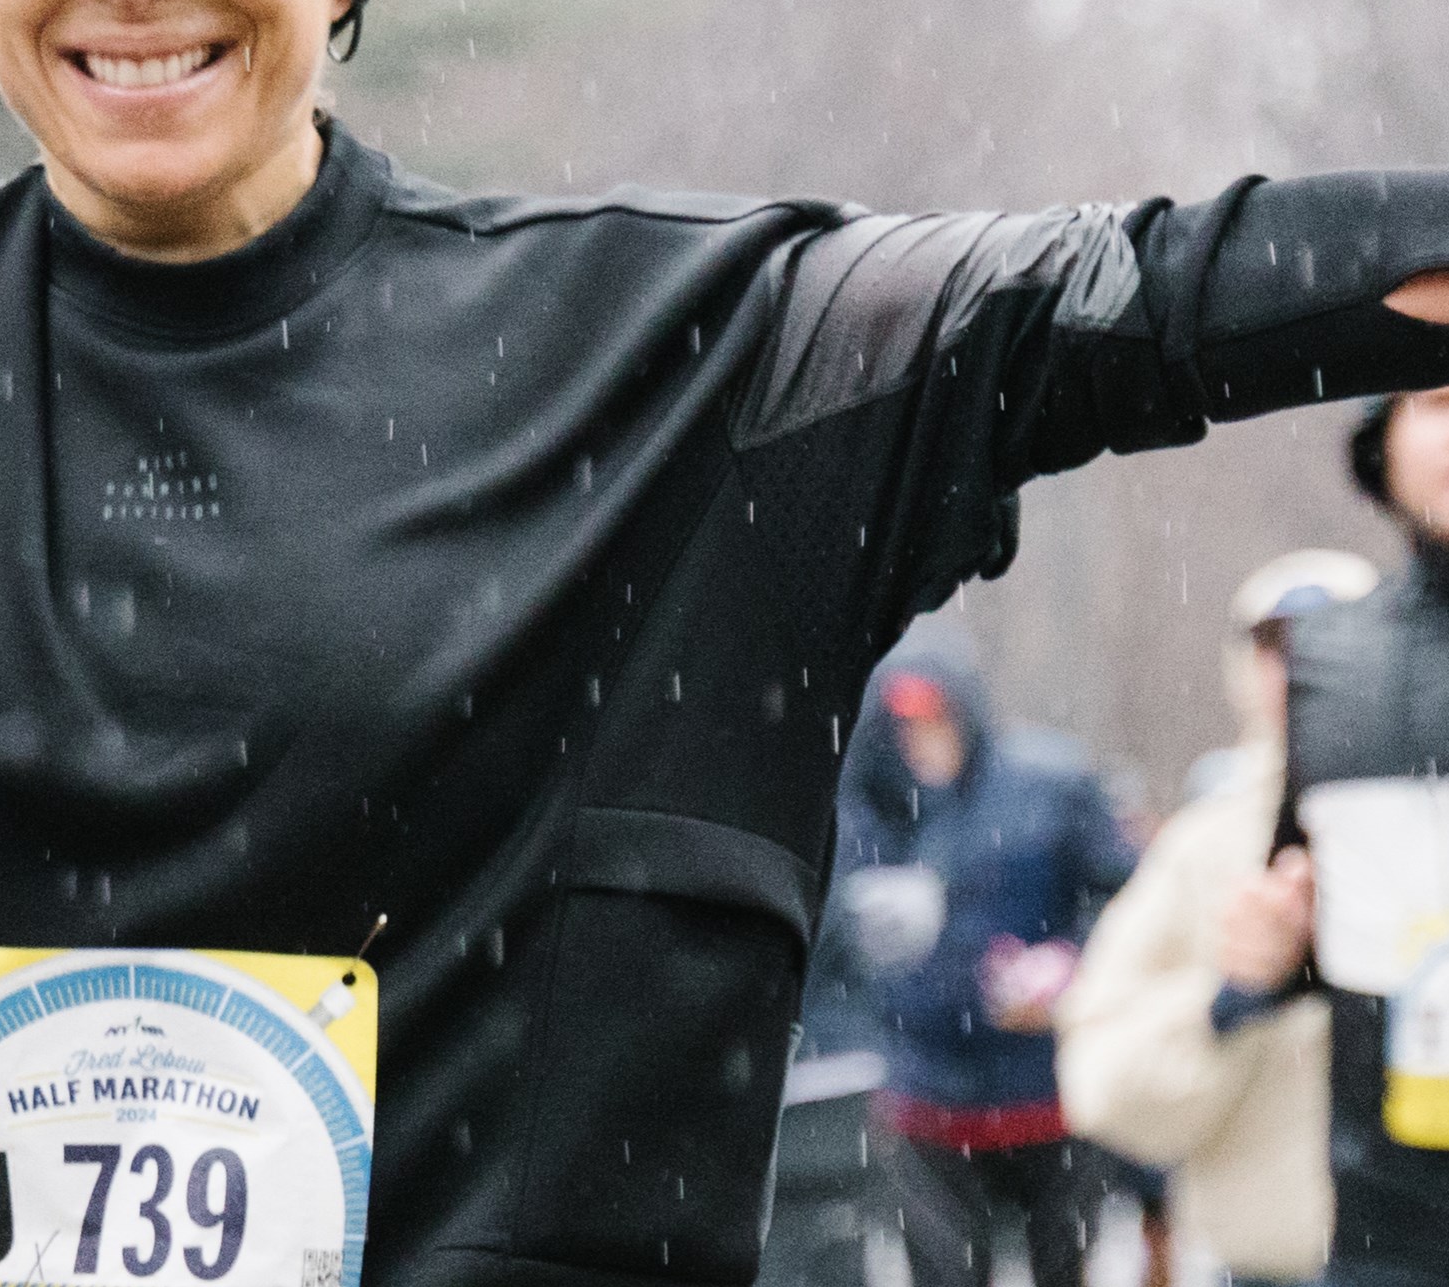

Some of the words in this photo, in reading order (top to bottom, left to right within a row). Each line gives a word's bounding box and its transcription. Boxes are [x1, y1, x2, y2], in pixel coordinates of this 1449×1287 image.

[63, 1047, 123, 1076] Fred
[129, 1043, 206, 1075] Lebow
[7, 1079, 82, 1115] HALF
[92, 1076, 261, 1122] MARATHON
[115, 1107, 157, 1123] 2024
[63, 1143, 248, 1281] 739
